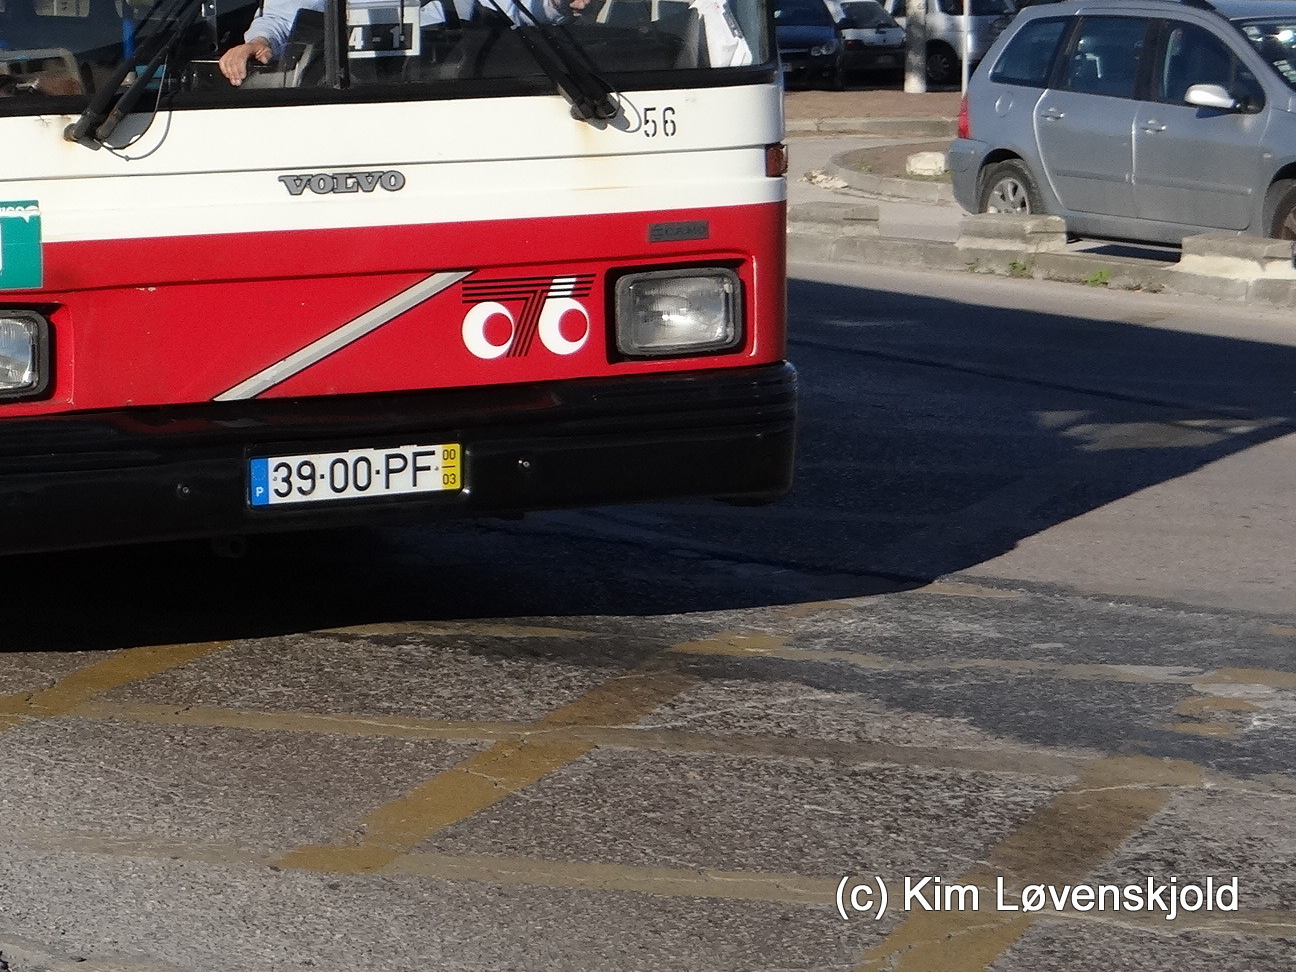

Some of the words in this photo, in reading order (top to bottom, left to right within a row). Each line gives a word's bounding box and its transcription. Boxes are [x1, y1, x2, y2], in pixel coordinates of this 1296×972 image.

[643, 106, 677, 138] 56
[278, 169, 406, 196] VOLVO
[442, 448, 456, 461] 00
[442, 473, 457, 485] 03
[255, 486, 264, 498] P
